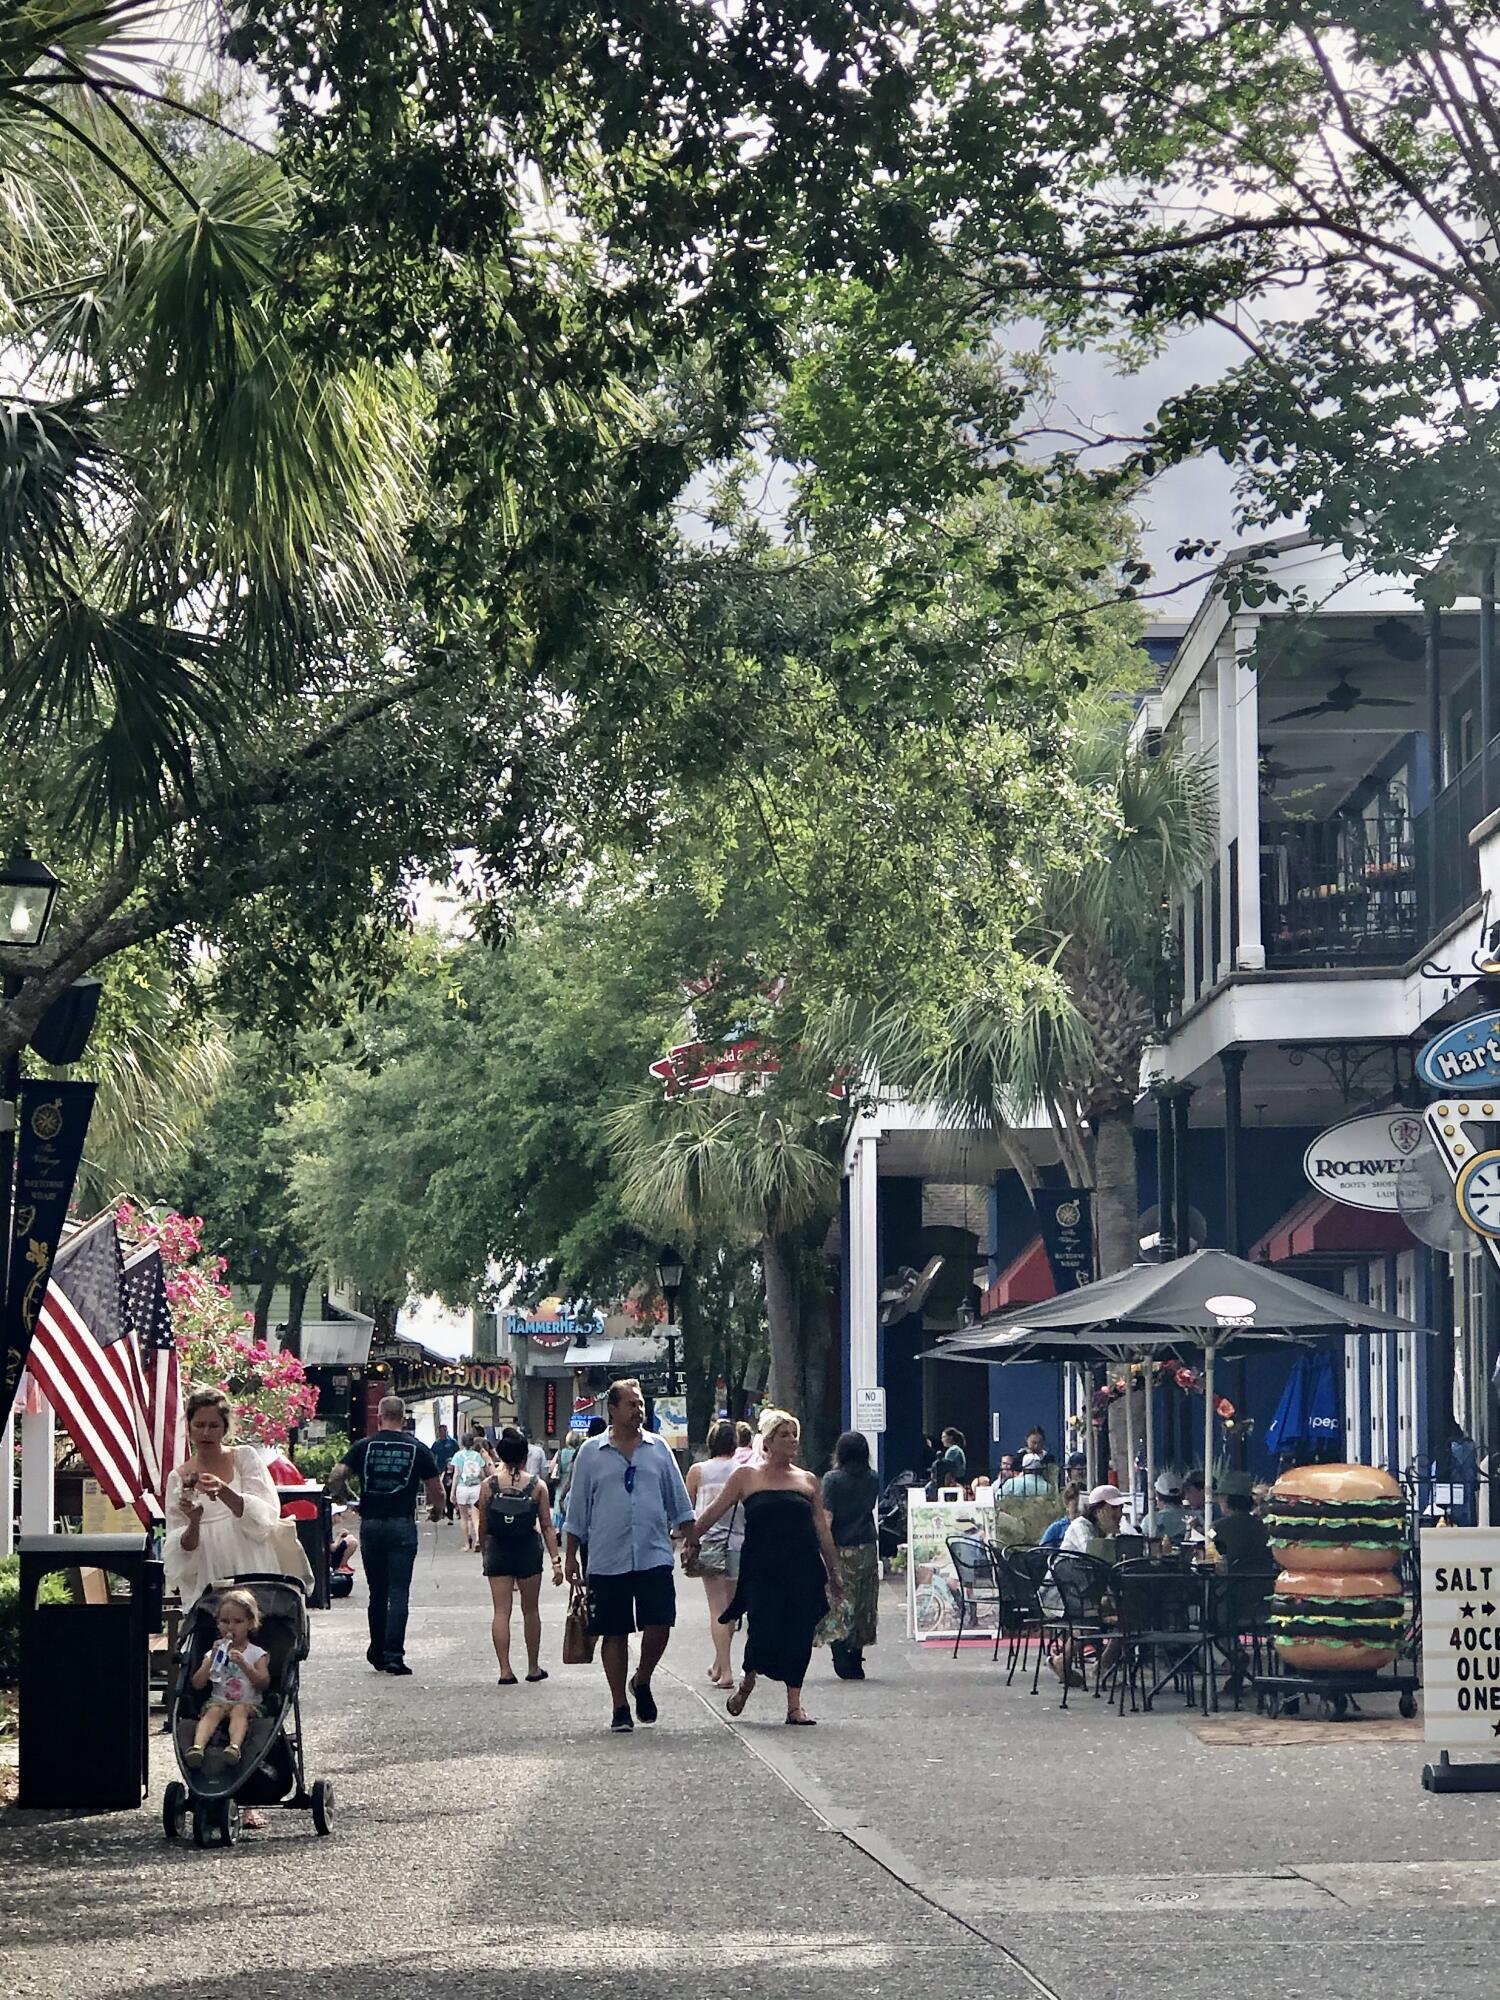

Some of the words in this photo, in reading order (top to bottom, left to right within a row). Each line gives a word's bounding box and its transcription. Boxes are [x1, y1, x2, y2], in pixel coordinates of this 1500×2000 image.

[1437, 1038, 1500, 1079] Hart
[456, 1364, 514, 1403] DOOR
[865, 1391, 876, 1401] NO
[1435, 1567, 1493, 1591] SALT
[1457, 1657, 1500, 1681] OLU
[1458, 1687, 1500, 1711] ONE
